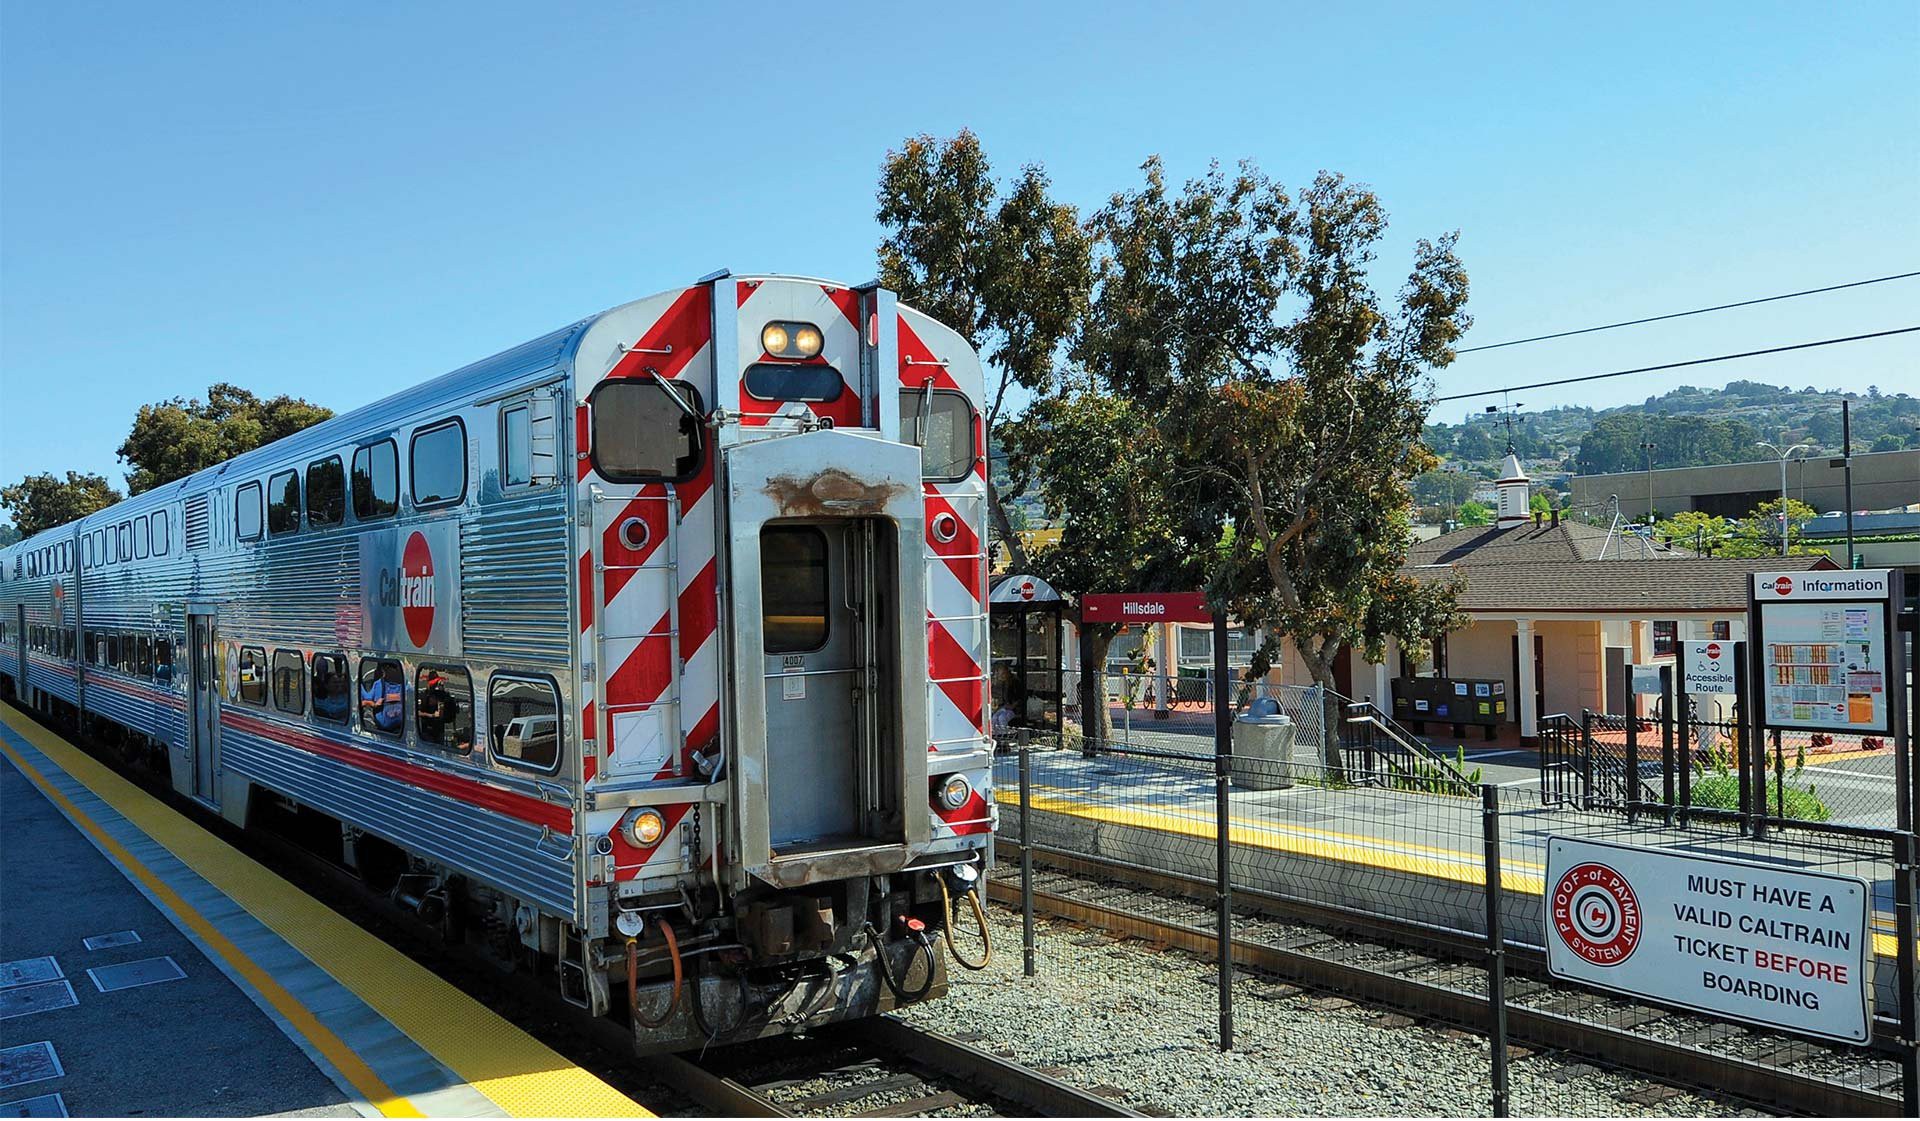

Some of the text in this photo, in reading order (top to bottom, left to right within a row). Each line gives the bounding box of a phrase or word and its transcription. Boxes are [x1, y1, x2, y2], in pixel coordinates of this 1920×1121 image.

[380, 566, 436, 608] Caltrain
[1802, 579, 1883, 592] Information
[1122, 602, 1165, 615] Hillsdale
[784, 656, 804, 665] 4007
[1686, 673, 1733, 683] Accessible
[1695, 683, 1724, 692] Route
[1687, 874, 1836, 914] MUST HAVE A
[1673, 903, 1850, 951] VALID CALTRAIN
[1571, 937, 1622, 960] SYSTEM
[1673, 934, 1848, 984] TICKET BEFORE
[1703, 971, 1820, 1011] BOARDING
